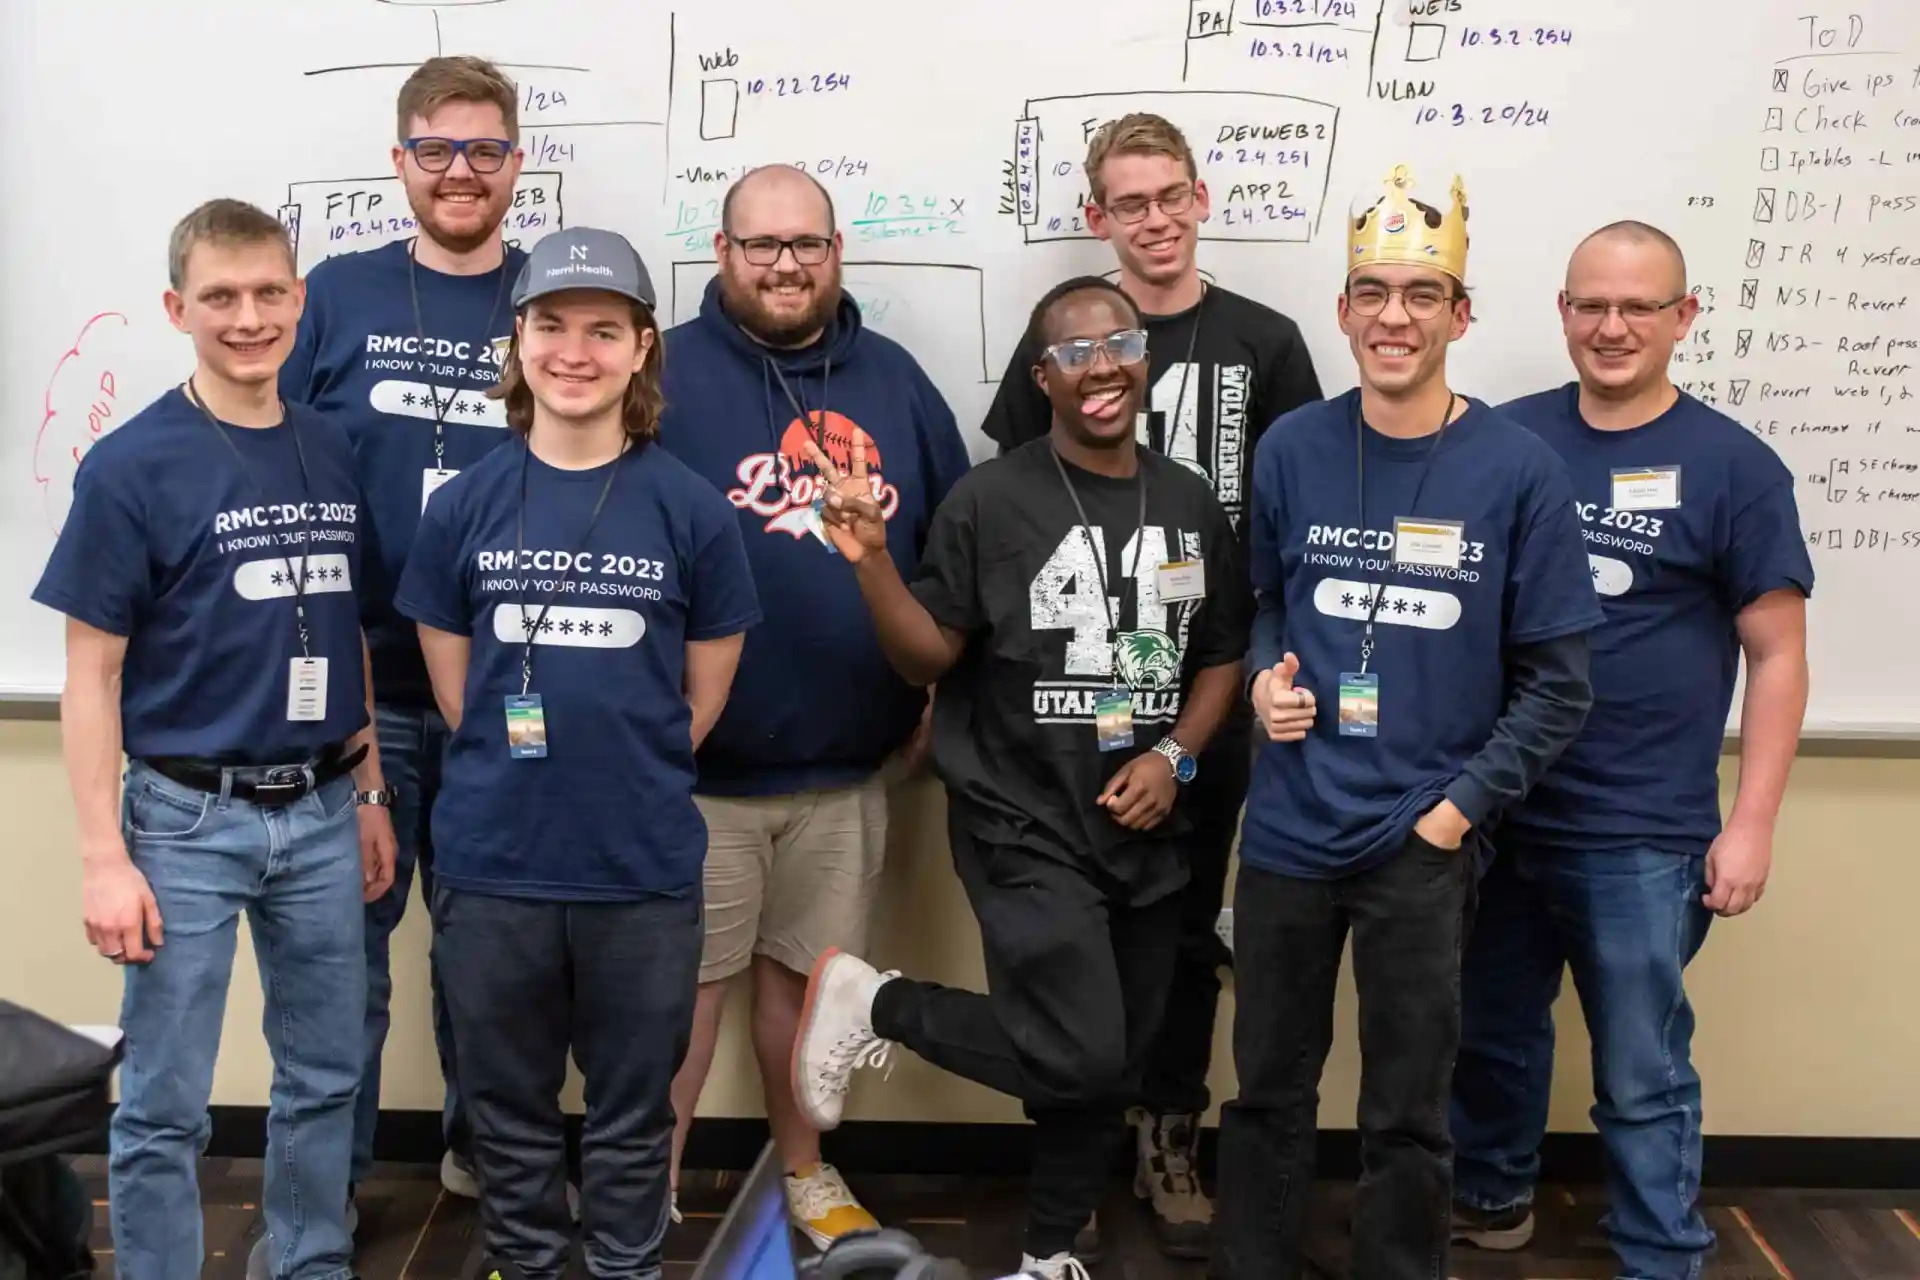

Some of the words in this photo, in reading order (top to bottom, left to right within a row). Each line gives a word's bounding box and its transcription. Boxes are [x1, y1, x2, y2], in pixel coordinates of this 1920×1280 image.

[1197, 12, 1224, 33] PA
[1798, 16, 1836, 49] To
[1376, 79, 1435, 101] VLAN
[1803, 69, 1852, 98] Give
[1867, 72, 1894, 97] ips
[1794, 105, 1868, 134] Check
[325, 190, 383, 220] FTP
[546, 264, 575, 278] Nemi
[576, 262, 614, 277] Health
[371, 359, 414, 372] KNOW
[318, 502, 358, 525] 2023
[1599, 507, 1664, 538] 2023
[227, 533, 273, 552] KNOW
[478, 550, 593, 573] RMCCDC
[600, 553, 665, 581] 2023
[1310, 553, 1354, 568] KNOW
[1397, 563, 1480, 583] PASSWORD
[533, 579, 576, 593] YOUR
[579, 581, 662, 602] PASSWORD
